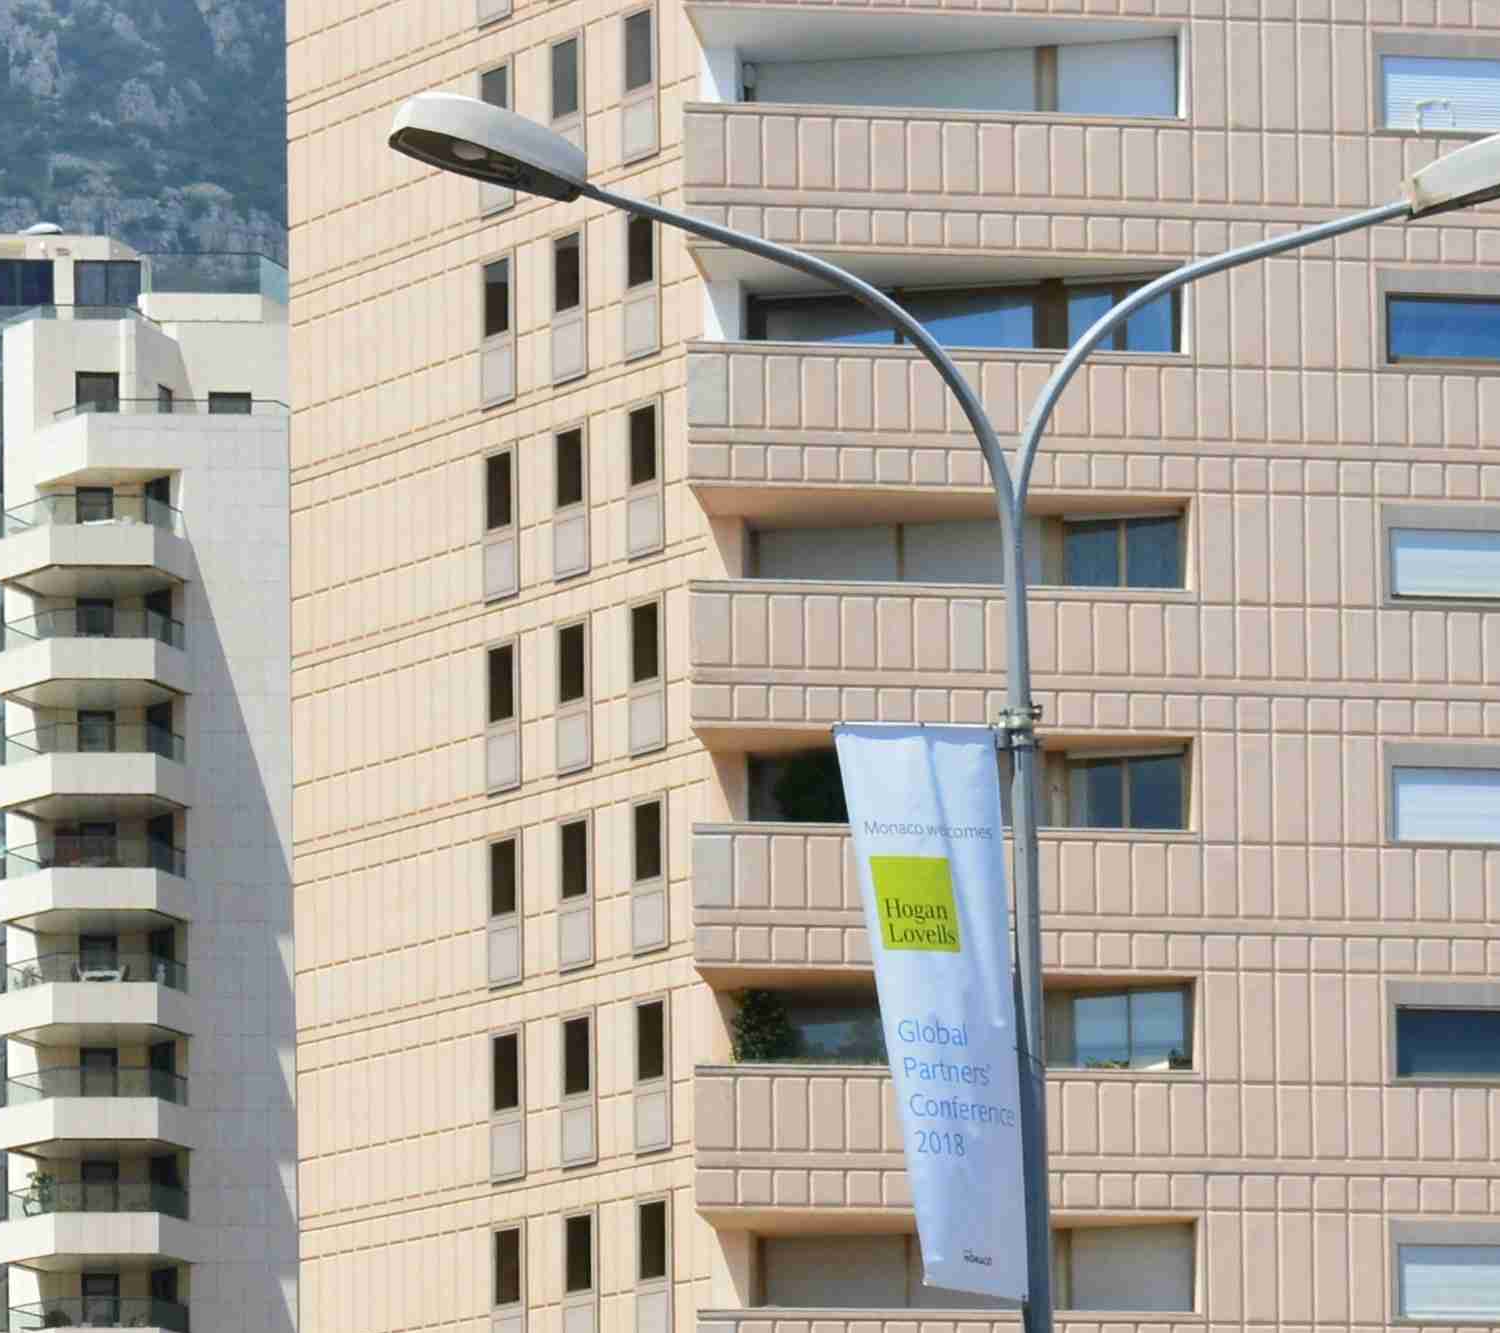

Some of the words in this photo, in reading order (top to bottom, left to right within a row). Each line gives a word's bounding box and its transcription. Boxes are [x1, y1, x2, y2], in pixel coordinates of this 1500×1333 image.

[863, 820, 924, 837] Monaco
[884, 897, 948, 924] Hogan
[889, 923, 957, 945] Lovells
[898, 1019, 968, 1047] Global
[909, 1093, 1015, 1127] Conference
[915, 1129, 966, 1157] 2018
